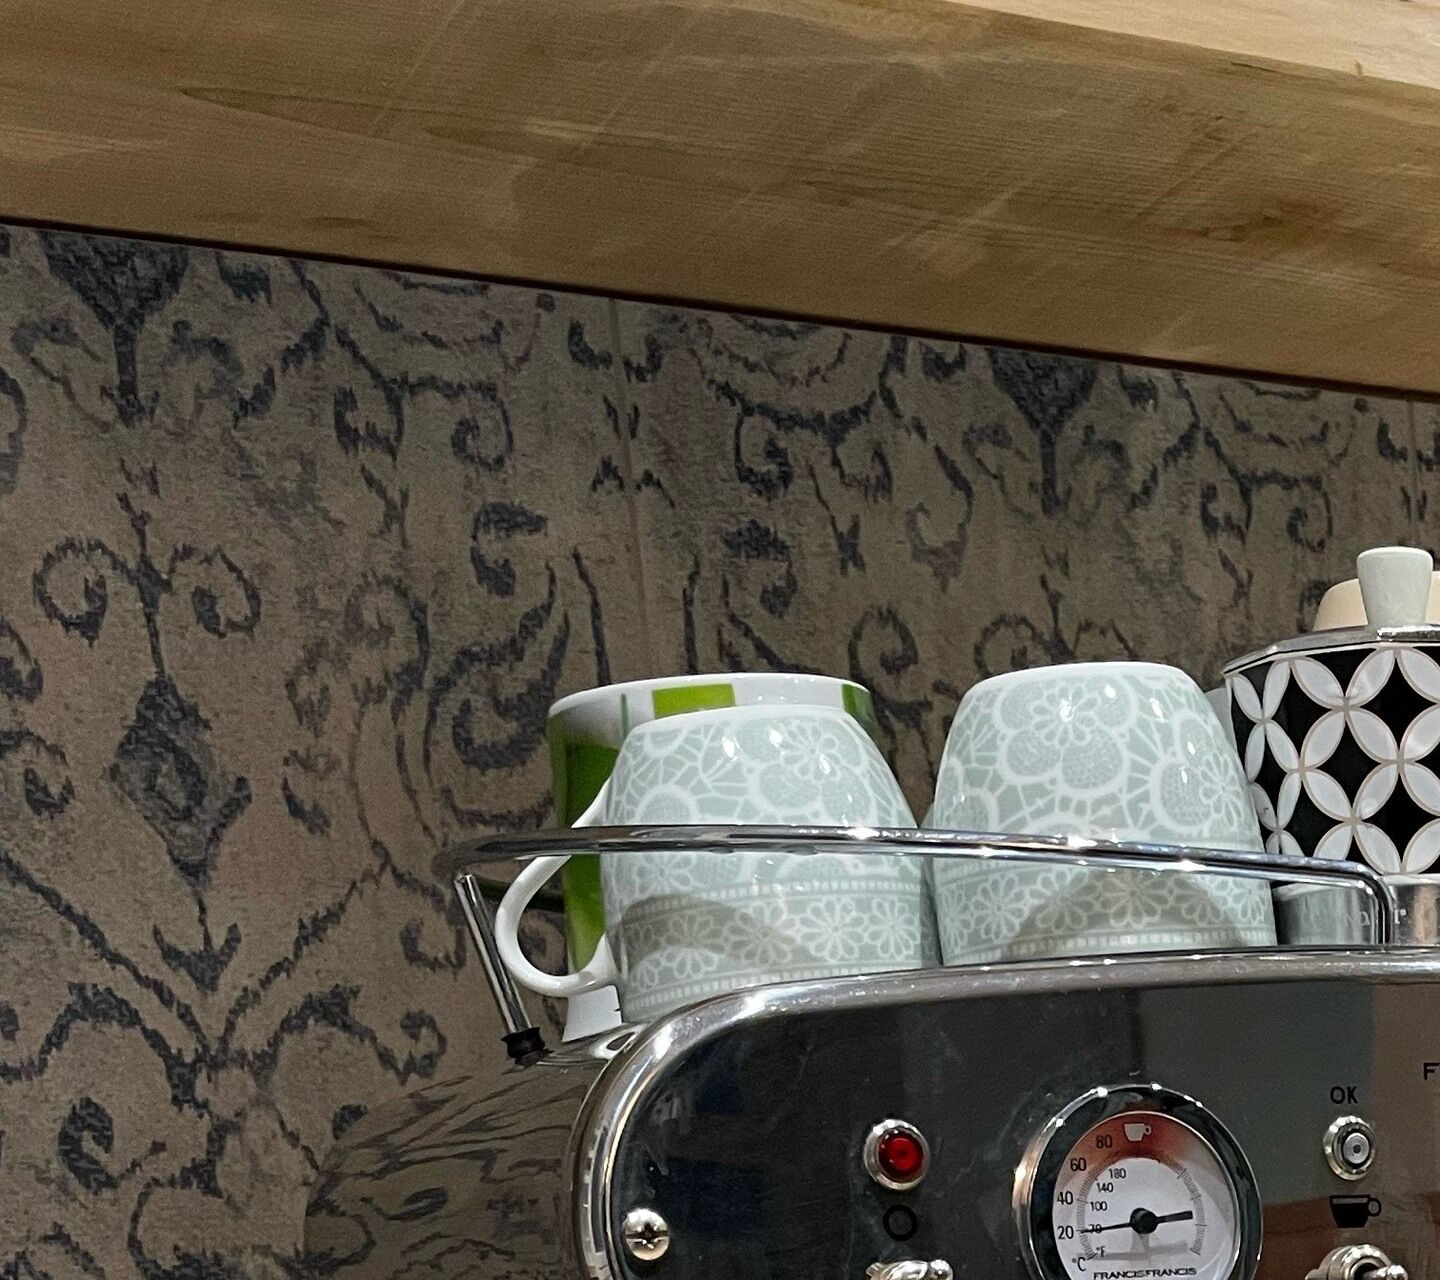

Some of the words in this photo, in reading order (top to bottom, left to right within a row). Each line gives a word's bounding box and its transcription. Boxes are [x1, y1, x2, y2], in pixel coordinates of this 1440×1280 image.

[1330, 1086, 1358, 1105] OK
[1095, 1135, 1113, 1148] 80
[1070, 1157, 1087, 1172] 60
[1096, 1182, 1114, 1193] 140
[1057, 1190, 1074, 1205] 40
[1089, 1201, 1108, 1212] 100
[1057, 1225, 1074, 1240] 20
[1093, 1268, 1198, 1280] FRANCISFRANCIS
